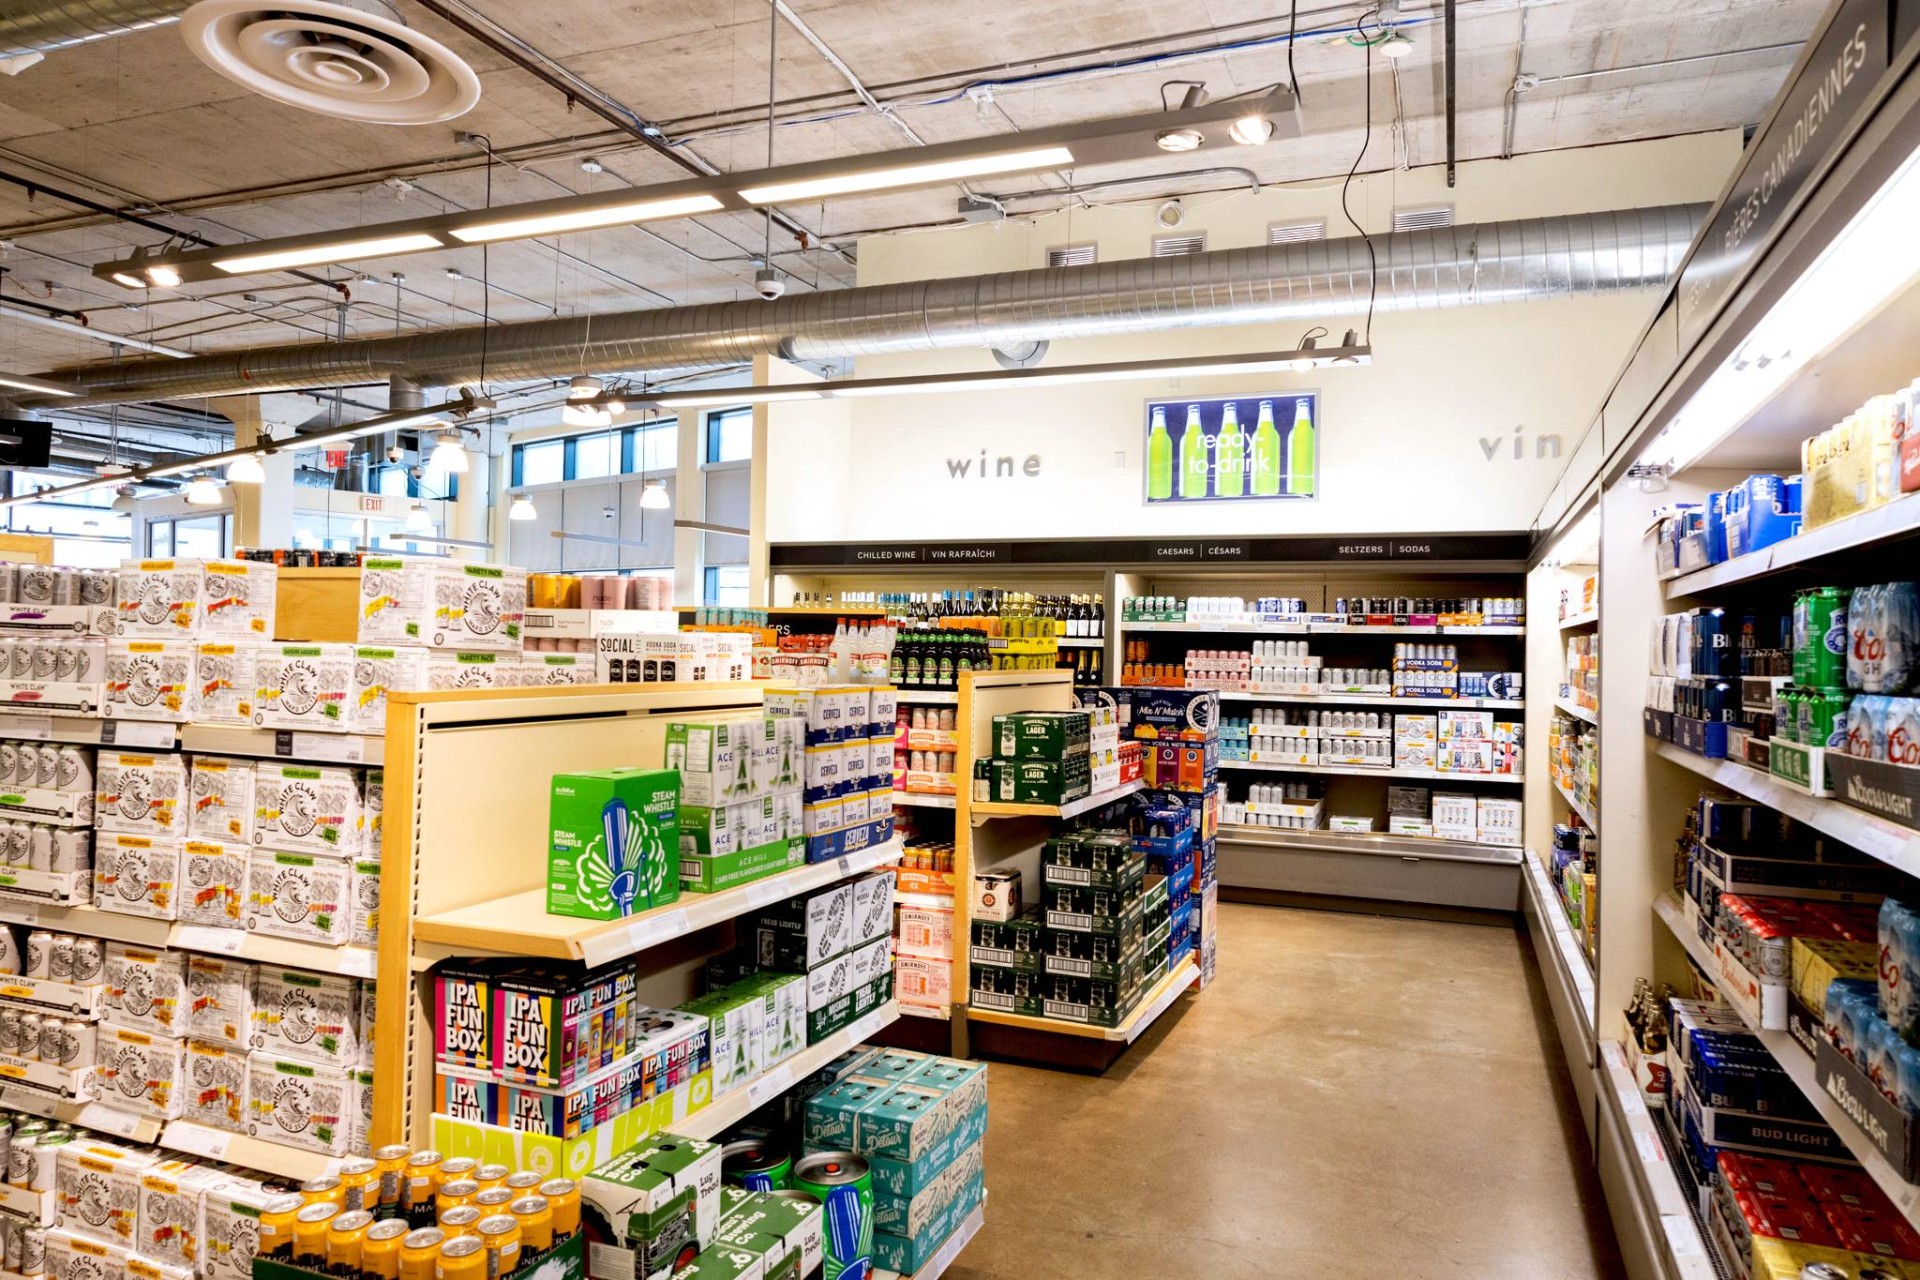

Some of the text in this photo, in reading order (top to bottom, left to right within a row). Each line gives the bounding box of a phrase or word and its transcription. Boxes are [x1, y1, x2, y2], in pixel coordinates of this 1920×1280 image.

[1762, 23, 1866, 204] CANADIENNES
[1196, 424, 1265, 455] ready-
[1479, 424, 1561, 462] vin
[946, 449, 1042, 479] wine
[1188, 447, 1270, 475] to-drink
[366, 499, 382, 511] EXIT
[857, 548, 996, 559] CHILLED WINE VIN RAFRAÎCHI
[1157, 546, 1241, 556] CAESARS CÉSARS
[1338, 545, 1431, 554] SELTZERS SODAS
[138, 573, 170, 605] WHITE CLAW
[464, 580, 501, 613] WHITE CLAW
[600, 638, 634, 653] SOCIAL
[126, 655, 160, 685] WHITE CLAW
[280, 660, 318, 693] WHITE CLAW
[471, 667, 494, 683] CLAW
[1025, 726, 1046, 735] LAGER
[717, 753, 733, 763] ACE
[766, 747, 779, 756] ACE
[117, 769, 150, 800] WHITE CLAW
[1024, 770, 1045, 779] LAGER
[279, 782, 317, 815] WHITE CLAW
[643, 799, 676, 814] WHISTLE
[652, 790, 676, 803] STEAM
[554, 830, 575, 839] STEAM
[764, 822, 777, 833] ACE
[554, 838, 582, 847] WHISTLE
[715, 834, 731, 845] ACE
[115, 850, 147, 880] WHITE CLAW
[272, 868, 310, 900] WHITE CLAW
[904, 912, 930, 921] SMIRNOFF
[900, 961, 926, 970] SMIRNOFF
[122, 964, 153, 994] WHITE CLAW
[280, 988, 317, 1020] WHITE CLAW
[450, 982, 479, 1007] IPA
[566, 994, 586, 1016] IPA
[589, 985, 612, 1005] FUN
[615, 974, 635, 994] BOX
[446, 1005, 484, 1030] FUN
[510, 996, 542, 1023] IPA
[766, 1016, 779, 1029] ACE
[446, 1027, 484, 1055] BOX
[505, 1021, 547, 1047] FUN
[505, 1042, 547, 1073] BOX
[645, 1056, 662, 1074] IPA
[666, 1045, 685, 1064] FUN
[688, 1033, 706, 1053] BOX
[715, 1041, 731, 1055] ACE
[115, 1045, 147, 1075] WHITE CLAW
[273, 1077, 311, 1109] WHITE CLAW
[451, 1082, 478, 1104] IPA
[568, 1093, 589, 1114] IPA
[592, 1079, 615, 1102] FUN
[619, 1065, 641, 1084] BOX
[447, 1102, 483, 1122] FUN
[514, 1095, 543, 1117] IPA
[510, 1115, 549, 1135] FUN
[813, 1122, 846, 1140] Detour
[867, 1132, 901, 1150] Detour
[1752, 1127, 1830, 1146] BUD LIGHT
[77, 1172, 110, 1202] WHITE CLAW
[700, 1173, 713, 1187] Lug
[700, 1178, 719, 1198] Tread
[720, 1214, 745, 1234] eau's
[720, 1211, 766, 1242] Brewing
[229, 1221, 243, 1250] WHITE
[735, 1232, 758, 1244] Co.
[804, 1232, 816, 1246] Lug
[82, 1255, 103, 1276] CLAW
